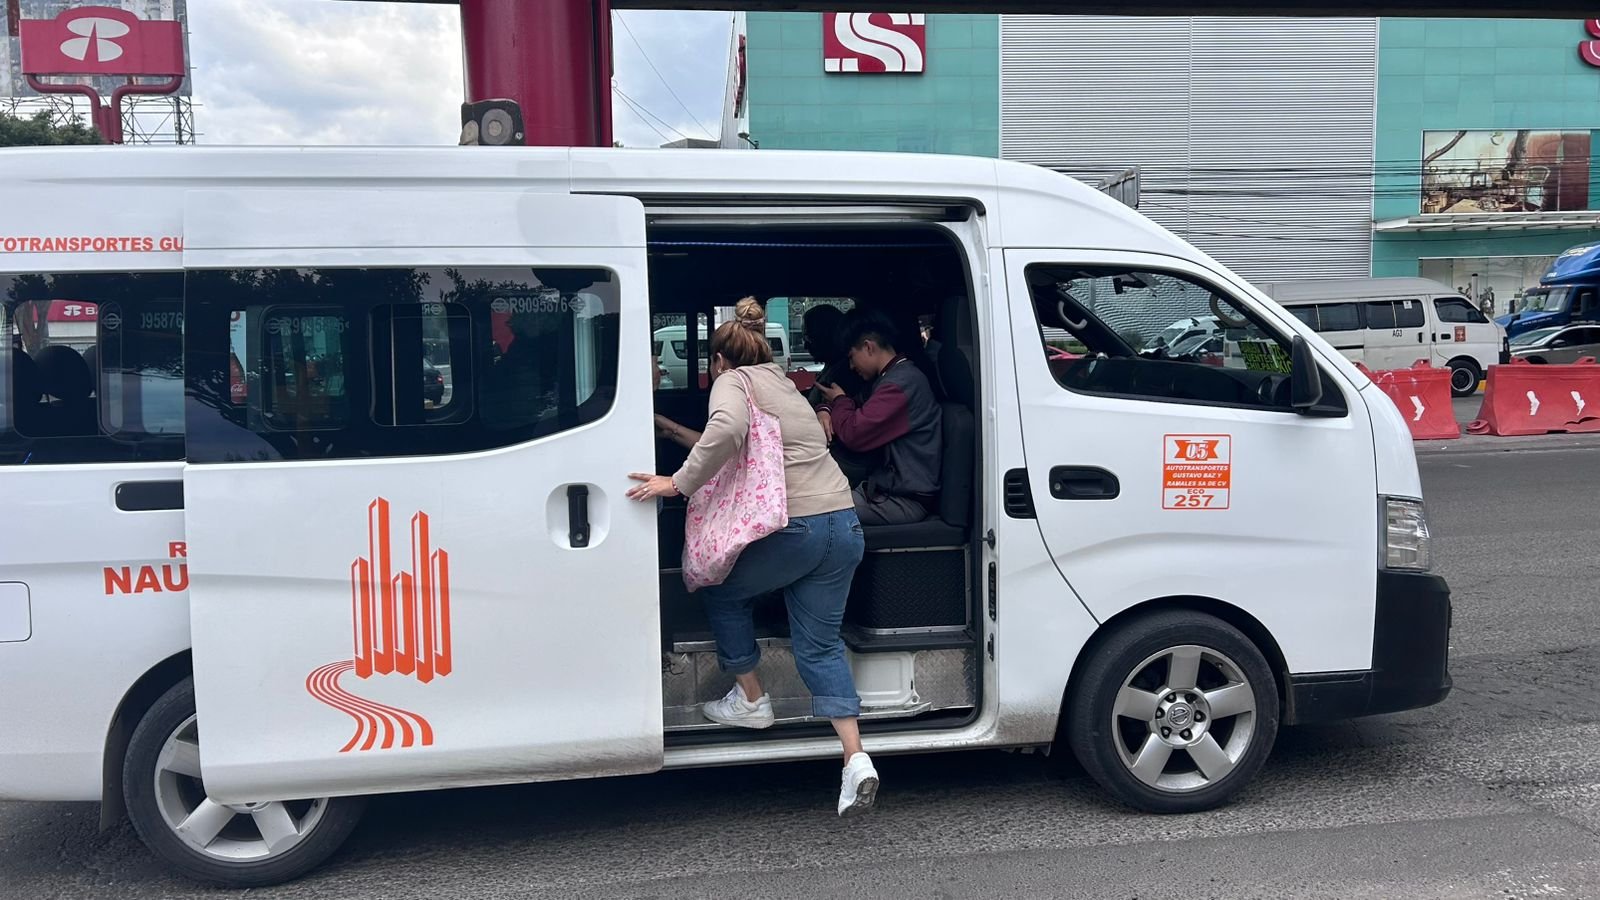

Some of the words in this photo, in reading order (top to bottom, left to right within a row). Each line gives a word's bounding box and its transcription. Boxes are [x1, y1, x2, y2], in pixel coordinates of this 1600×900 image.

[85, 306, 98, 315] B
[1392, 329, 1403, 337] AG3
[1186, 443, 1208, 459] 05
[1174, 494, 1214, 507] 257
[168, 541, 187, 558] R
[103, 563, 189, 595] NAU
